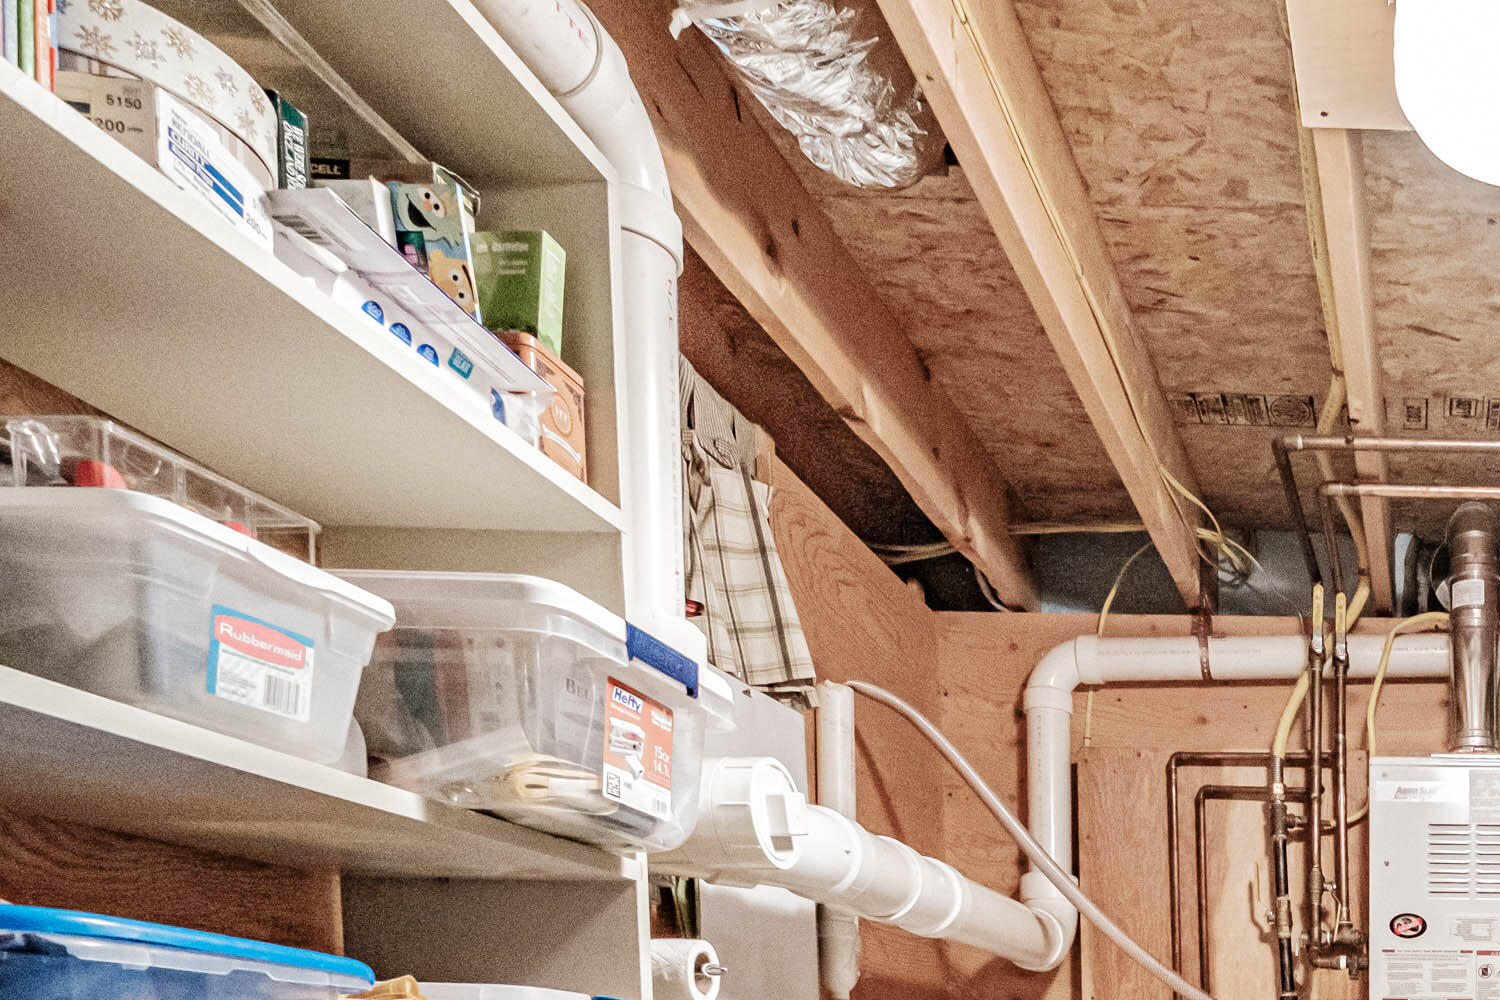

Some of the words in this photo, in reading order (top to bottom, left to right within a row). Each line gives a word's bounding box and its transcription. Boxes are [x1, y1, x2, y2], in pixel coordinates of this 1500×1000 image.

[106, 93, 142, 110] 5150
[220, 621, 303, 661] Rubbermaid
[613, 688, 642, 713] Hefty
